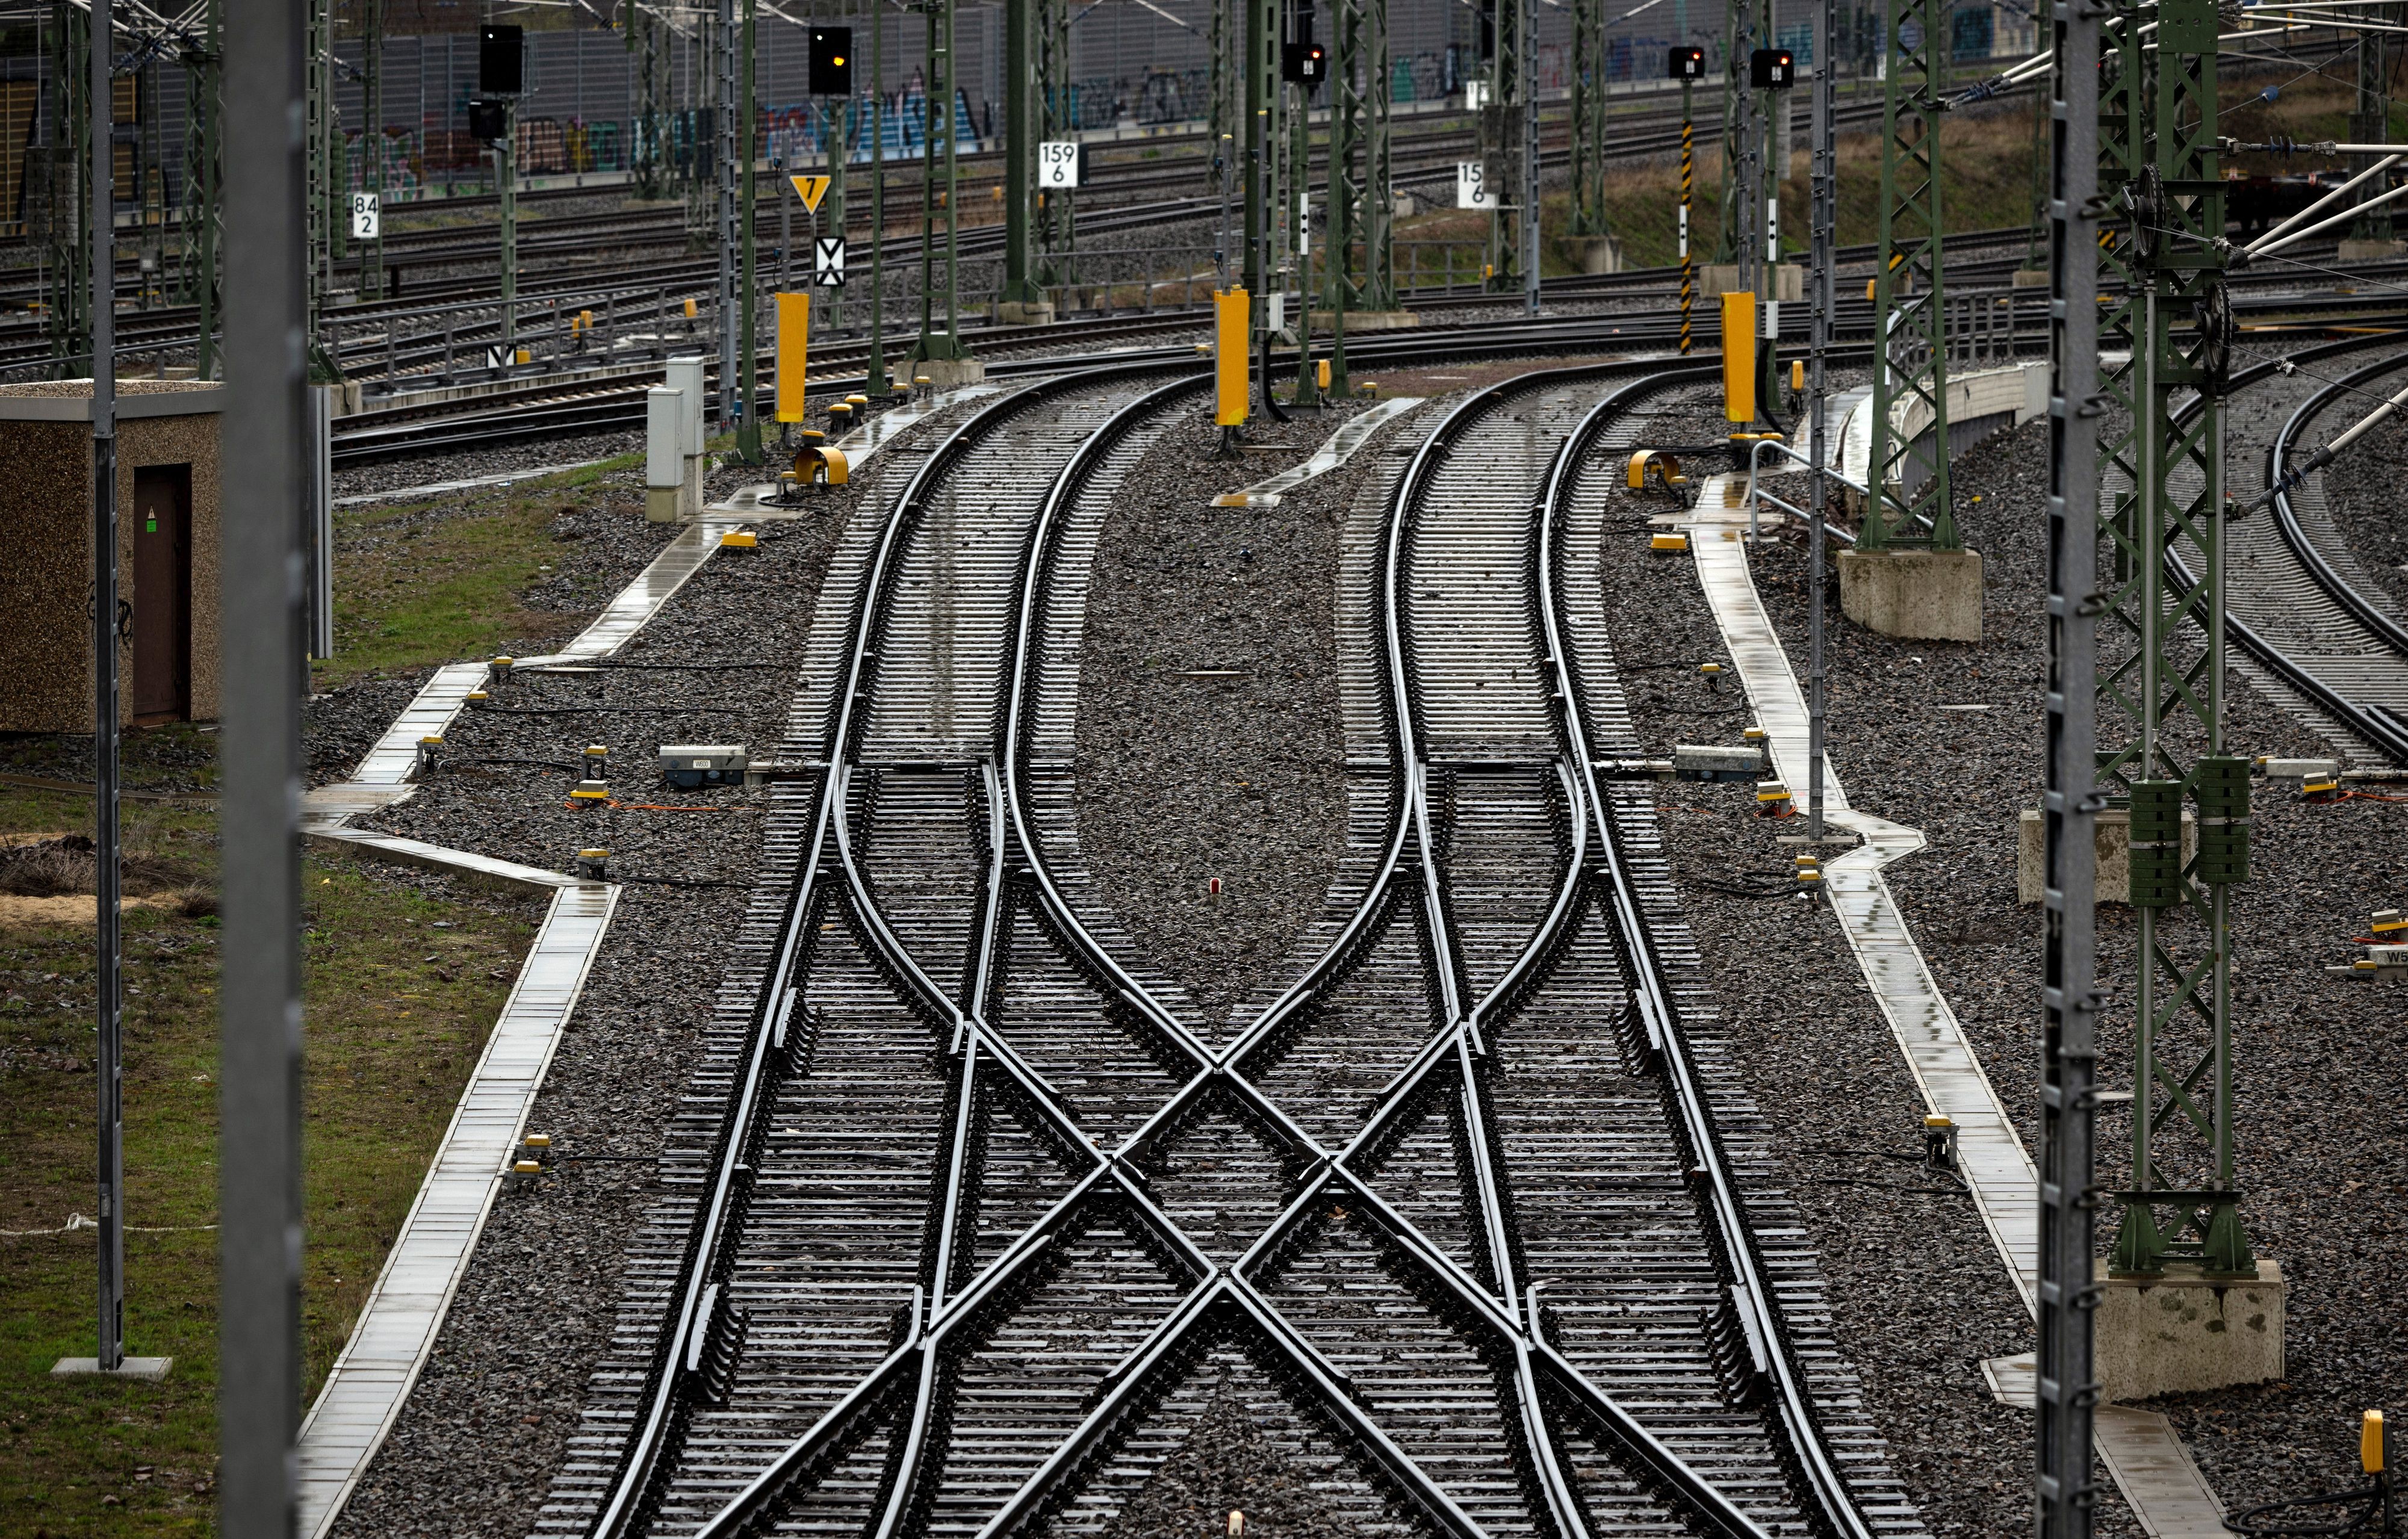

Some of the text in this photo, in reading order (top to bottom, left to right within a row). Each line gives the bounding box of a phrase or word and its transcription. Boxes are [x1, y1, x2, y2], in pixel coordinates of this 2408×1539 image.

[1042, 144, 1074, 163] 159
[1053, 165, 1064, 182] 6
[1462, 164, 1482, 182] 15
[806, 178, 816, 199] 7
[1472, 184, 1485, 203] 6
[355, 197, 377, 214] 84
[362, 216, 371, 233] 2
